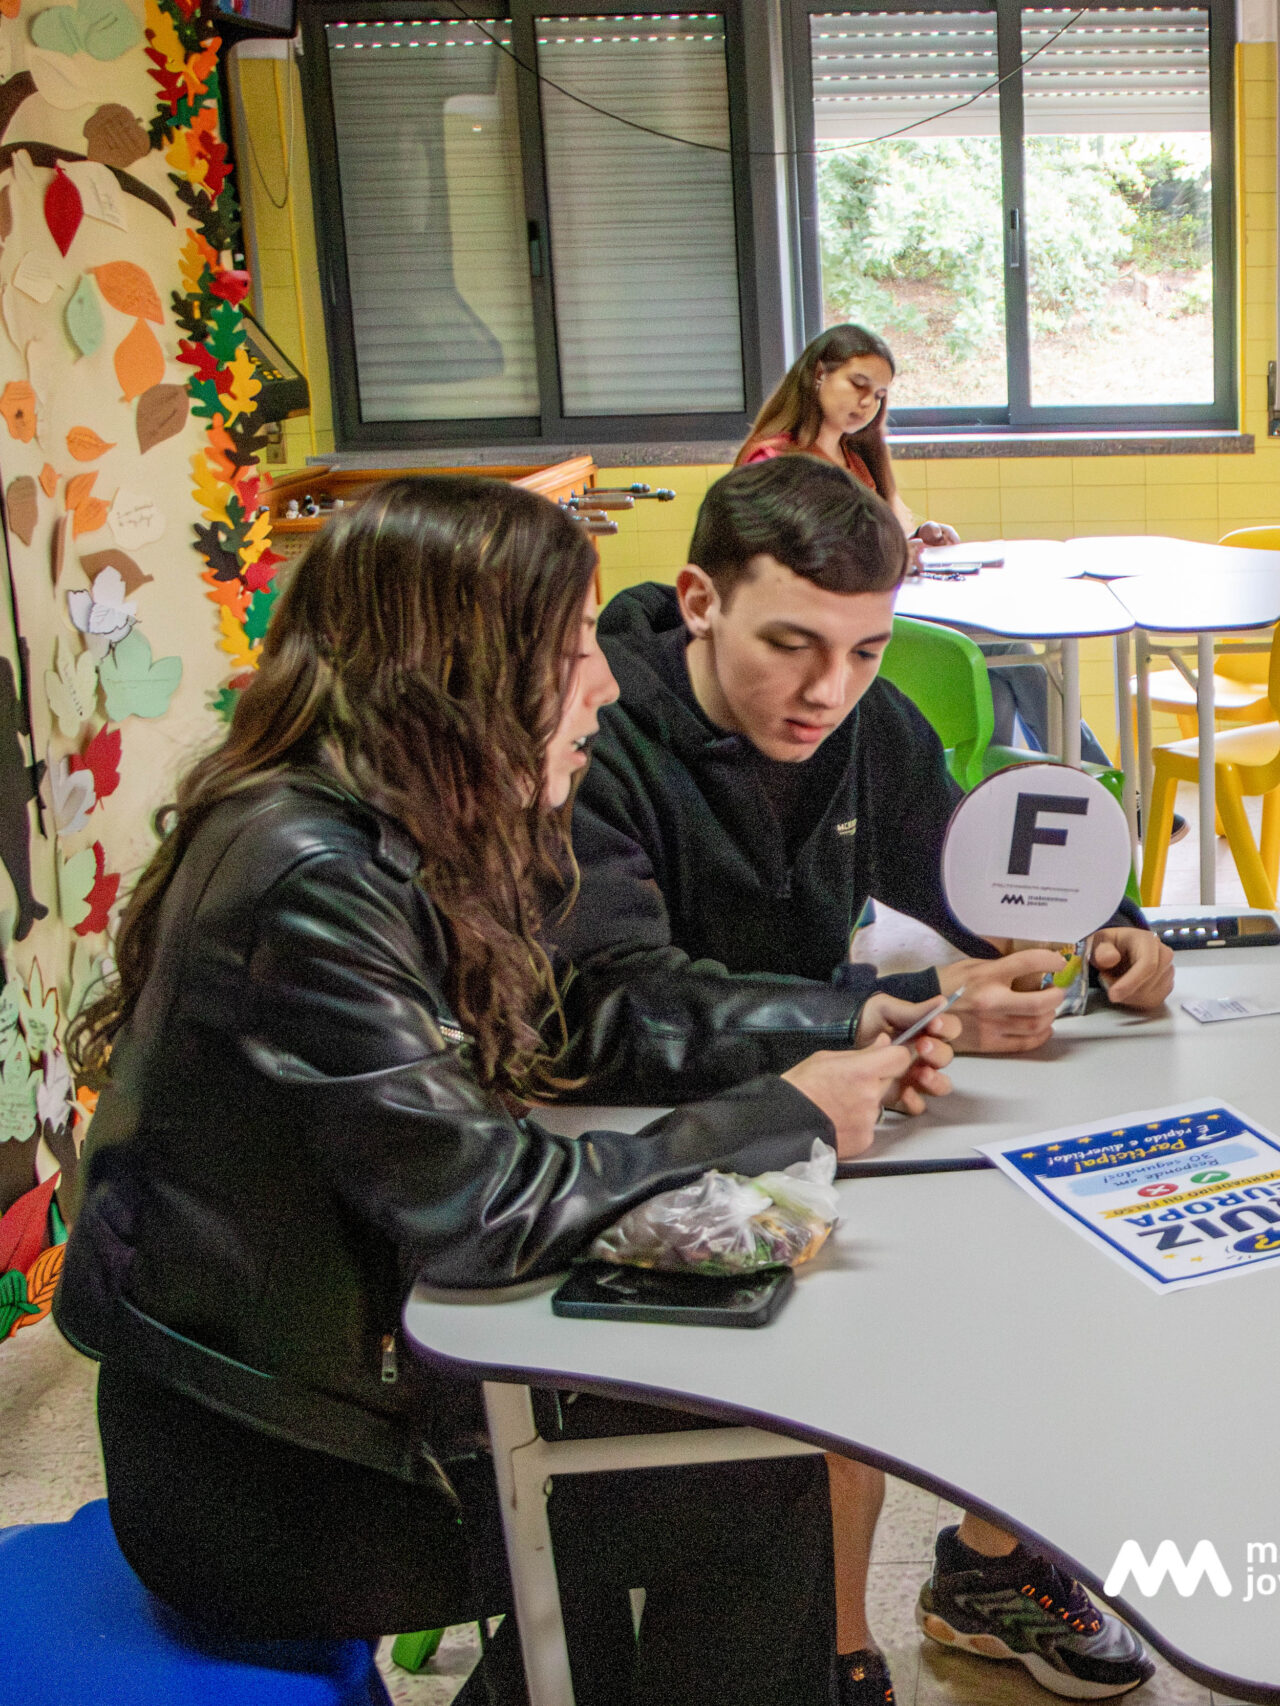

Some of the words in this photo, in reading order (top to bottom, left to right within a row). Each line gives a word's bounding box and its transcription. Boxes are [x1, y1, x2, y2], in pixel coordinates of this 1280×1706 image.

[1007, 792, 1090, 876] F
[1144, 1127, 1193, 1144] rápido
[1047, 1142, 1125, 1167] divertido!
[1074, 1138, 1188, 1173] Participa!
[1188, 1151, 1215, 1163] 30
[1103, 1158, 1182, 1184] segundos!
[1144, 1159, 1220, 1181] Responde
[1113, 1177, 1139, 1188] em
